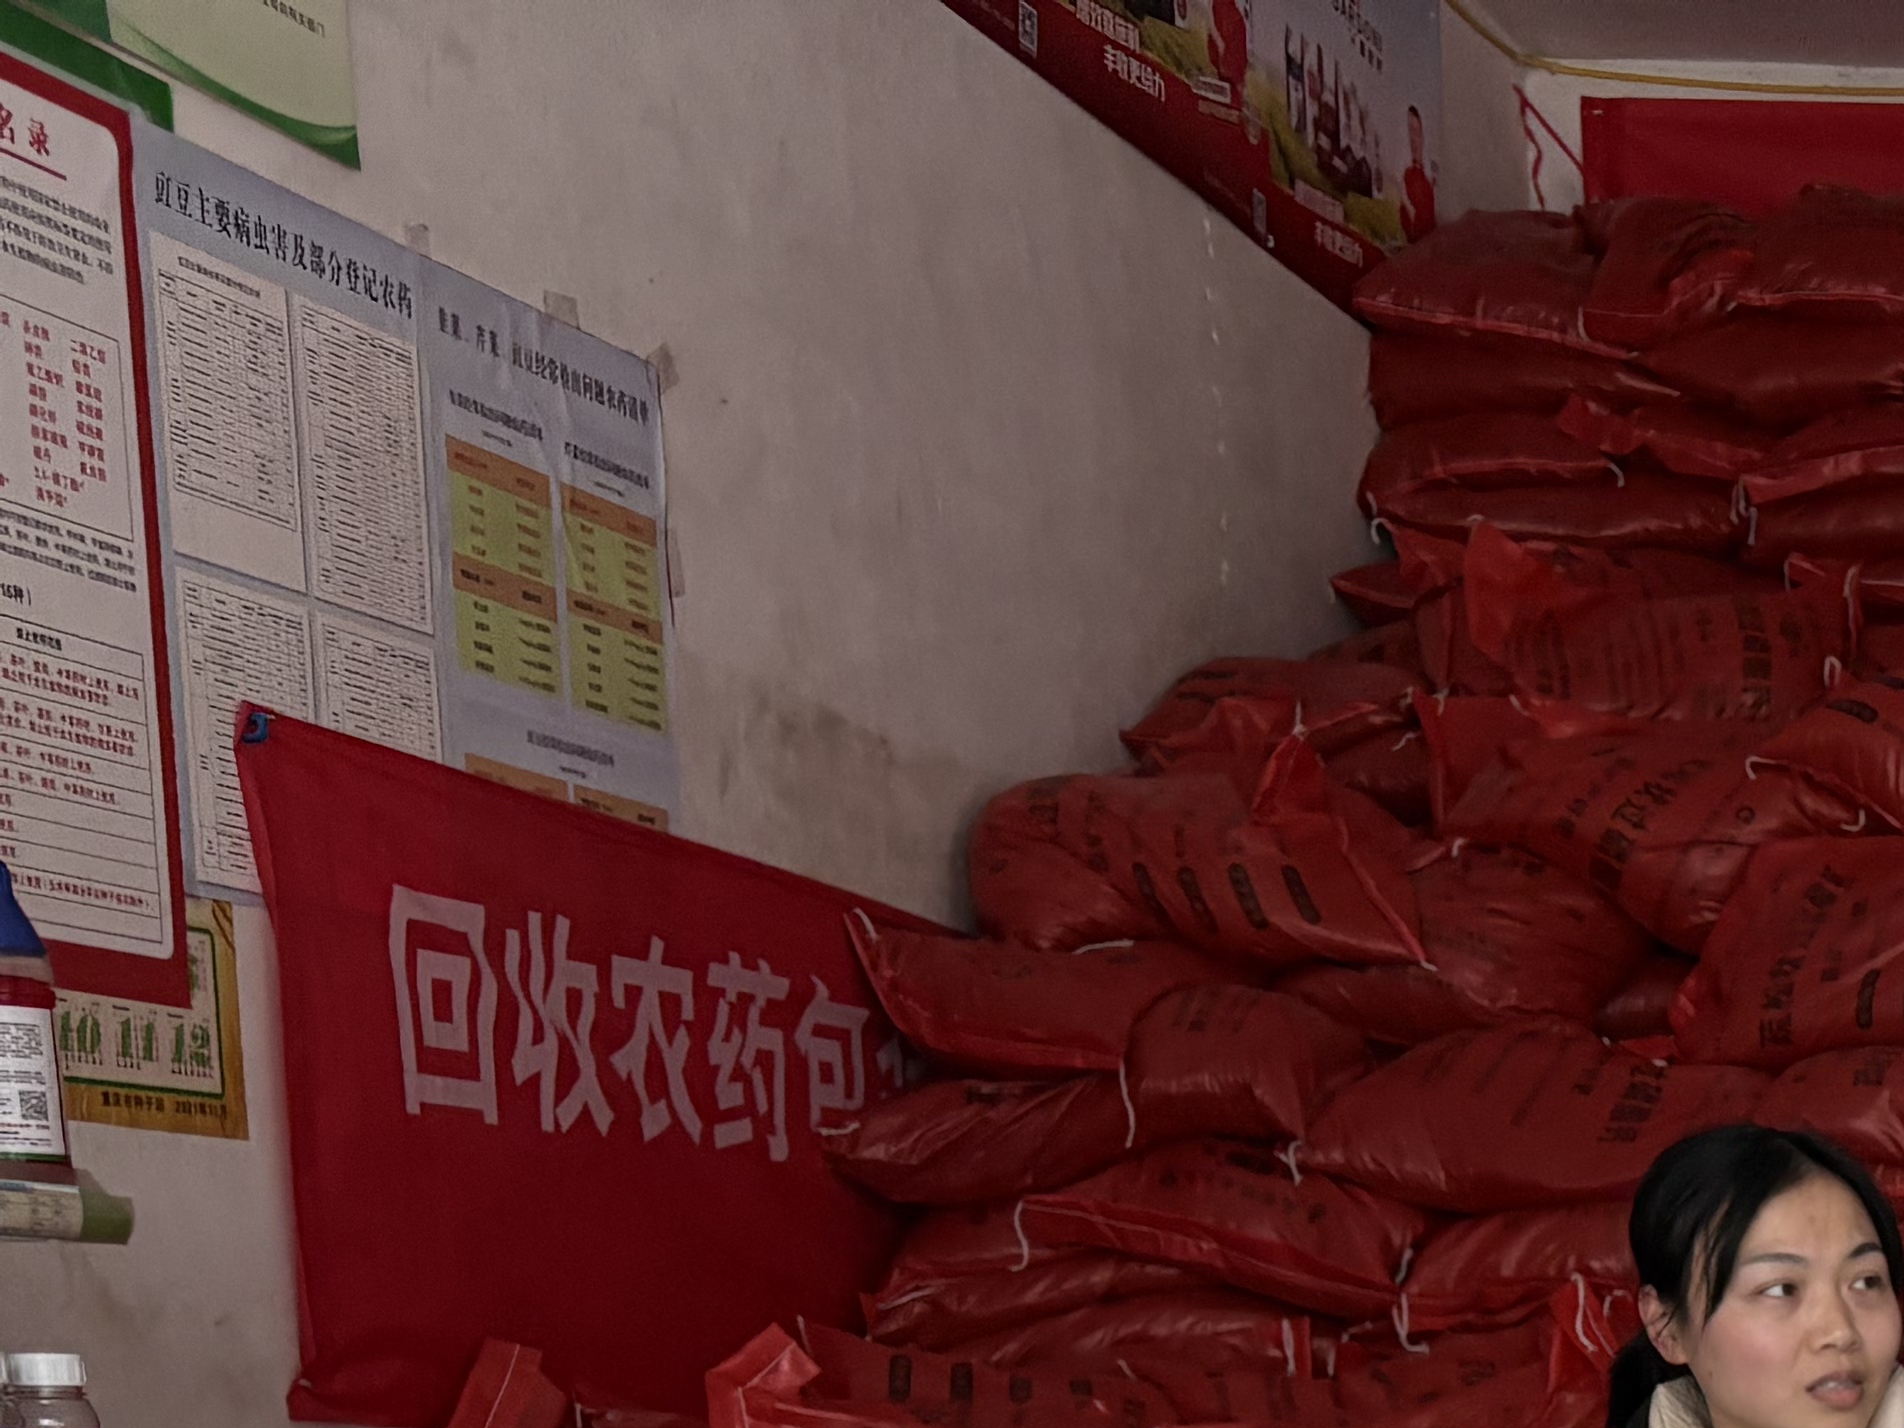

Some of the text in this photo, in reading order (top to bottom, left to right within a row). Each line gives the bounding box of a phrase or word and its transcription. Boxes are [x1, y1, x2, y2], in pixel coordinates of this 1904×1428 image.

[154, 171, 413, 319] 豇豆主要病虫害及部分登记农药
[390, 898, 870, 1162] 回收农药包
